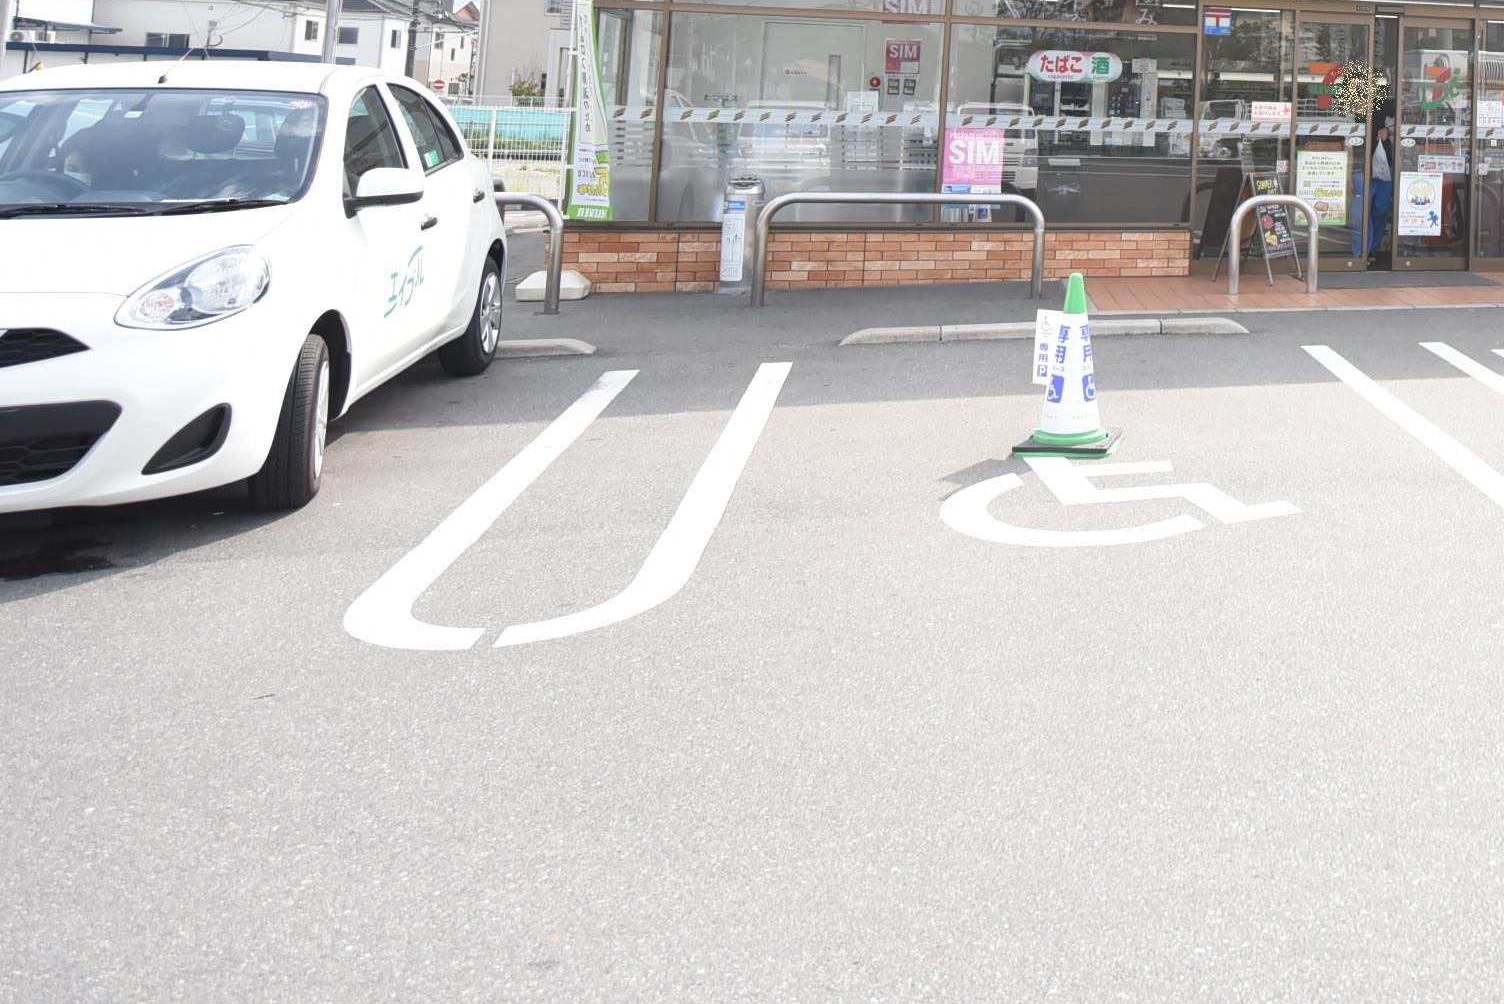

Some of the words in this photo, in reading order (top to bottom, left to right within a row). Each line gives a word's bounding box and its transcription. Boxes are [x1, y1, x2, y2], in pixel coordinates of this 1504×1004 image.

[889, 44, 918, 59] SIM
[1039, 54, 1083, 74] たばこ
[1091, 56, 1110, 75] 酒
[948, 139, 1000, 165] SIM
[388, 256, 425, 307] エイブル
